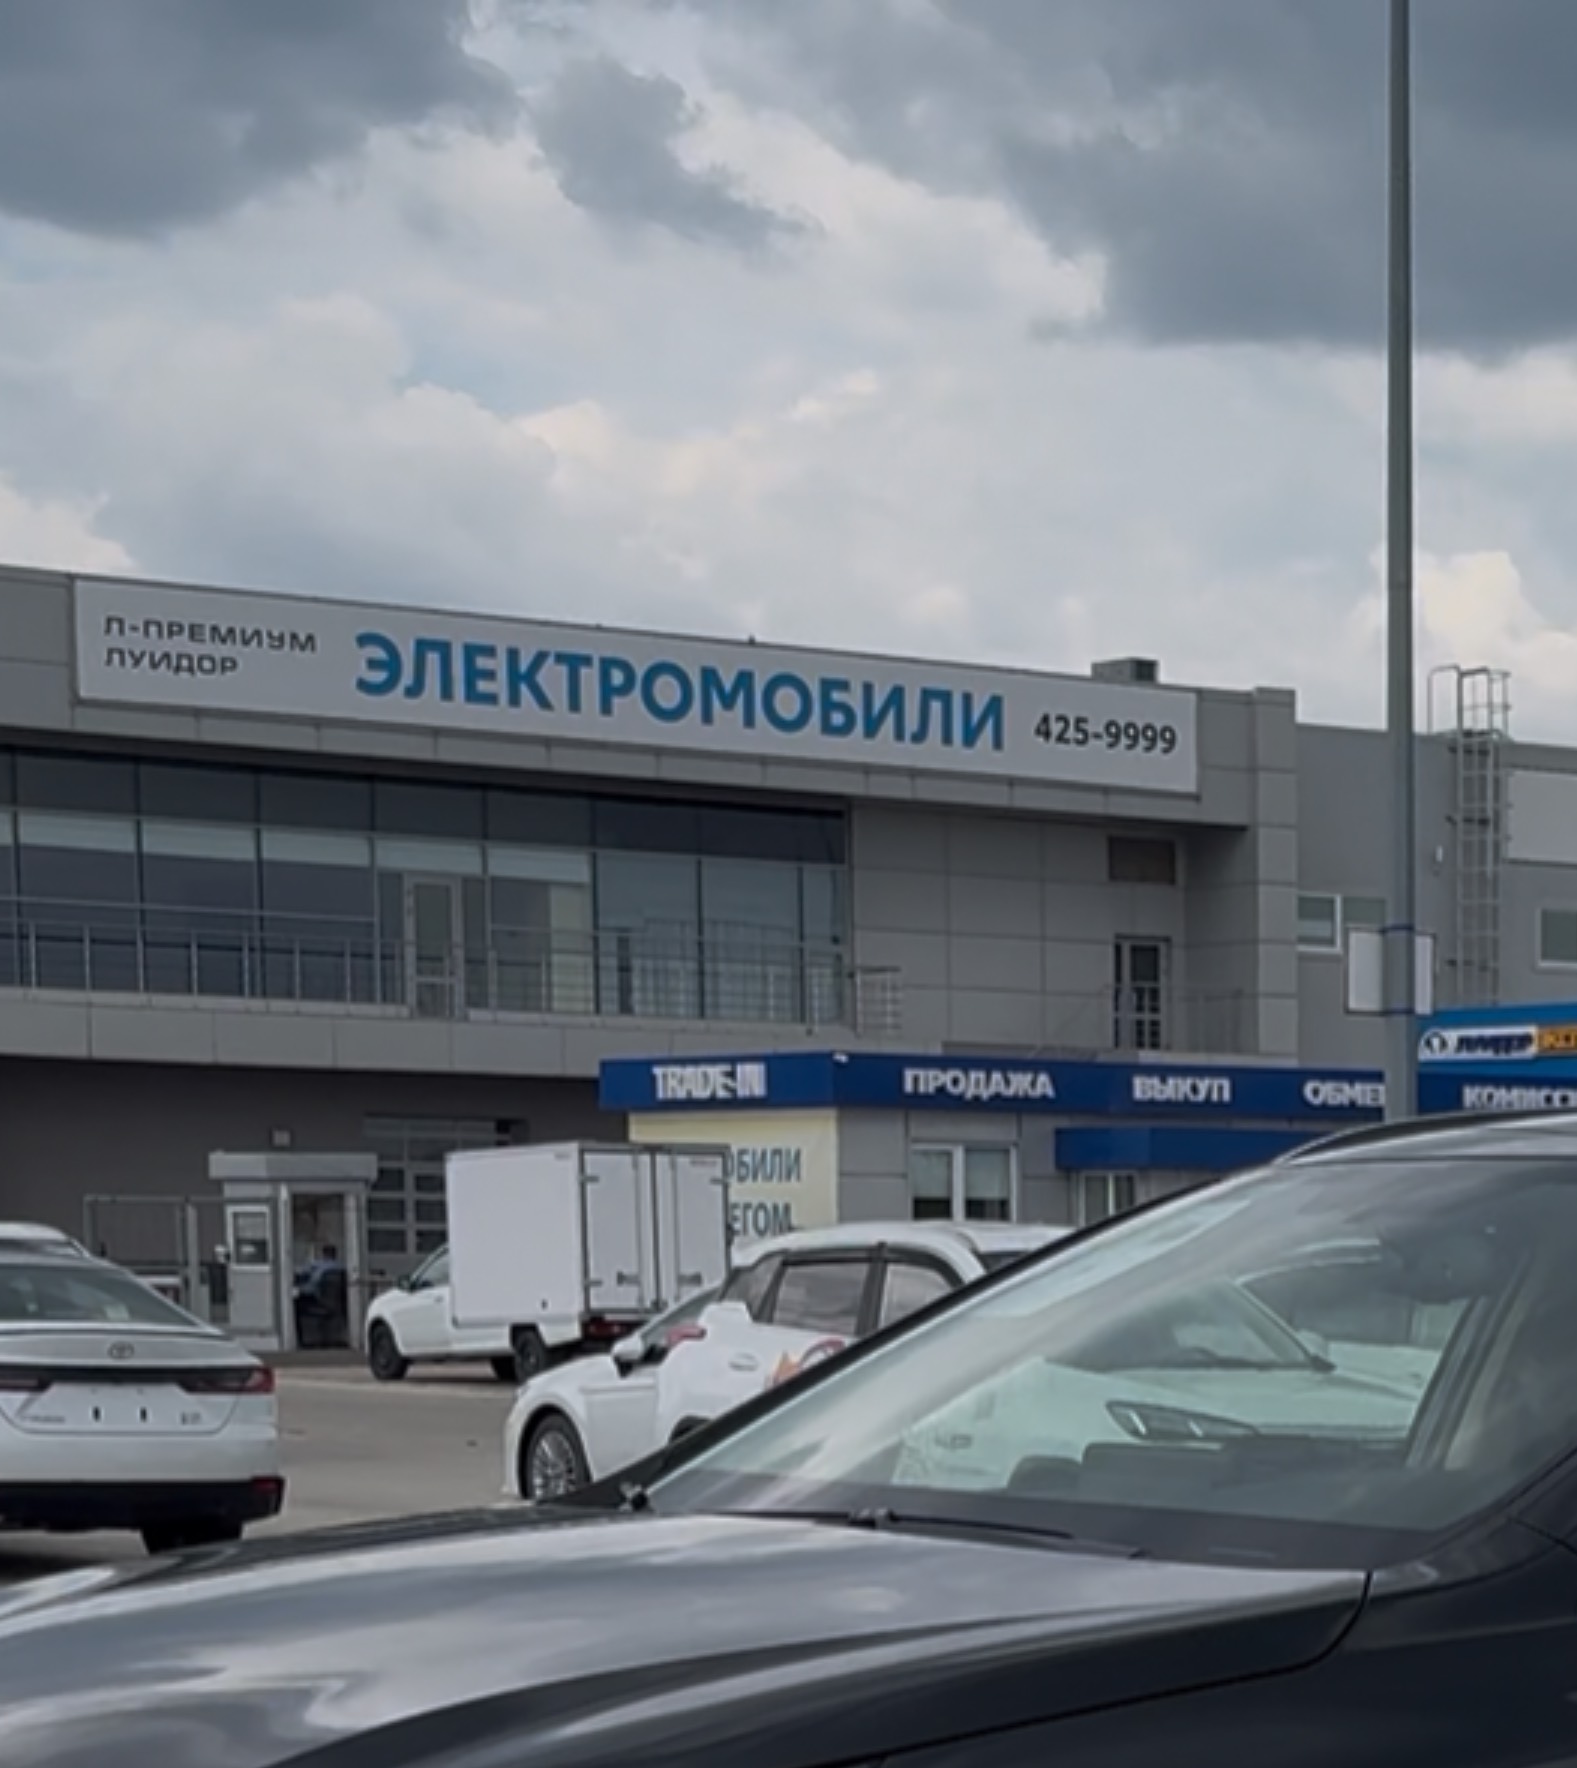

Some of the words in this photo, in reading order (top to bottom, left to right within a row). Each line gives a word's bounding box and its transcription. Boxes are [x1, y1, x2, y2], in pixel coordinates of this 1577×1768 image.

[104, 615, 317, 653] Л-ПРЕМИУМ
[104, 647, 238, 677] ЛУИДОР
[354, 632, 1004, 751] ЭЛЕКТРОМОБИЛИ
[1034, 713, 1177, 754] 425-9999
[652, 1062, 766, 1100] TRADE-IN
[903, 1066, 1055, 1100] ПРОДАЖА
[1133, 1075, 1231, 1103] ВЫКУП
[1303, 1080, 1386, 1107] ОБМЕ
